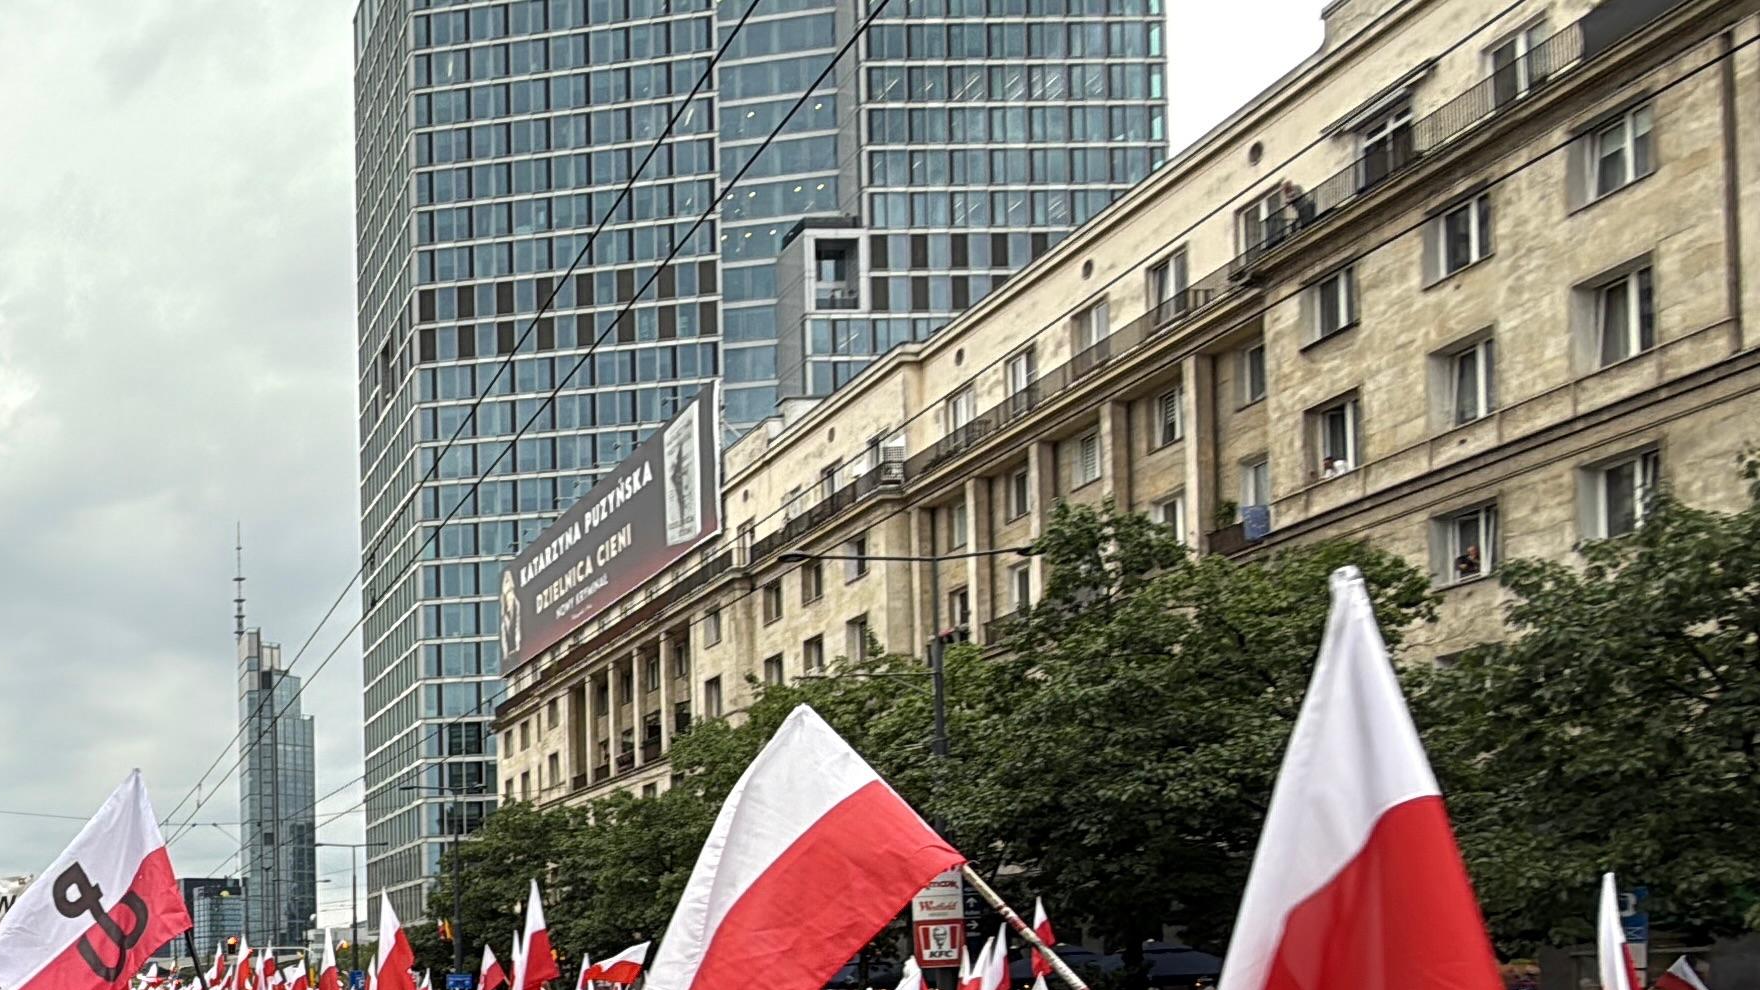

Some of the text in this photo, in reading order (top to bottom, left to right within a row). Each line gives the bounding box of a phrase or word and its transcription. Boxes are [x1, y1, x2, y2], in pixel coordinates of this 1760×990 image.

[520, 460, 653, 587] KATARZYNA PUZYŃSKA
[536, 523, 632, 614] DZIELNICA CIENI
[929, 950, 953, 958] KFC
